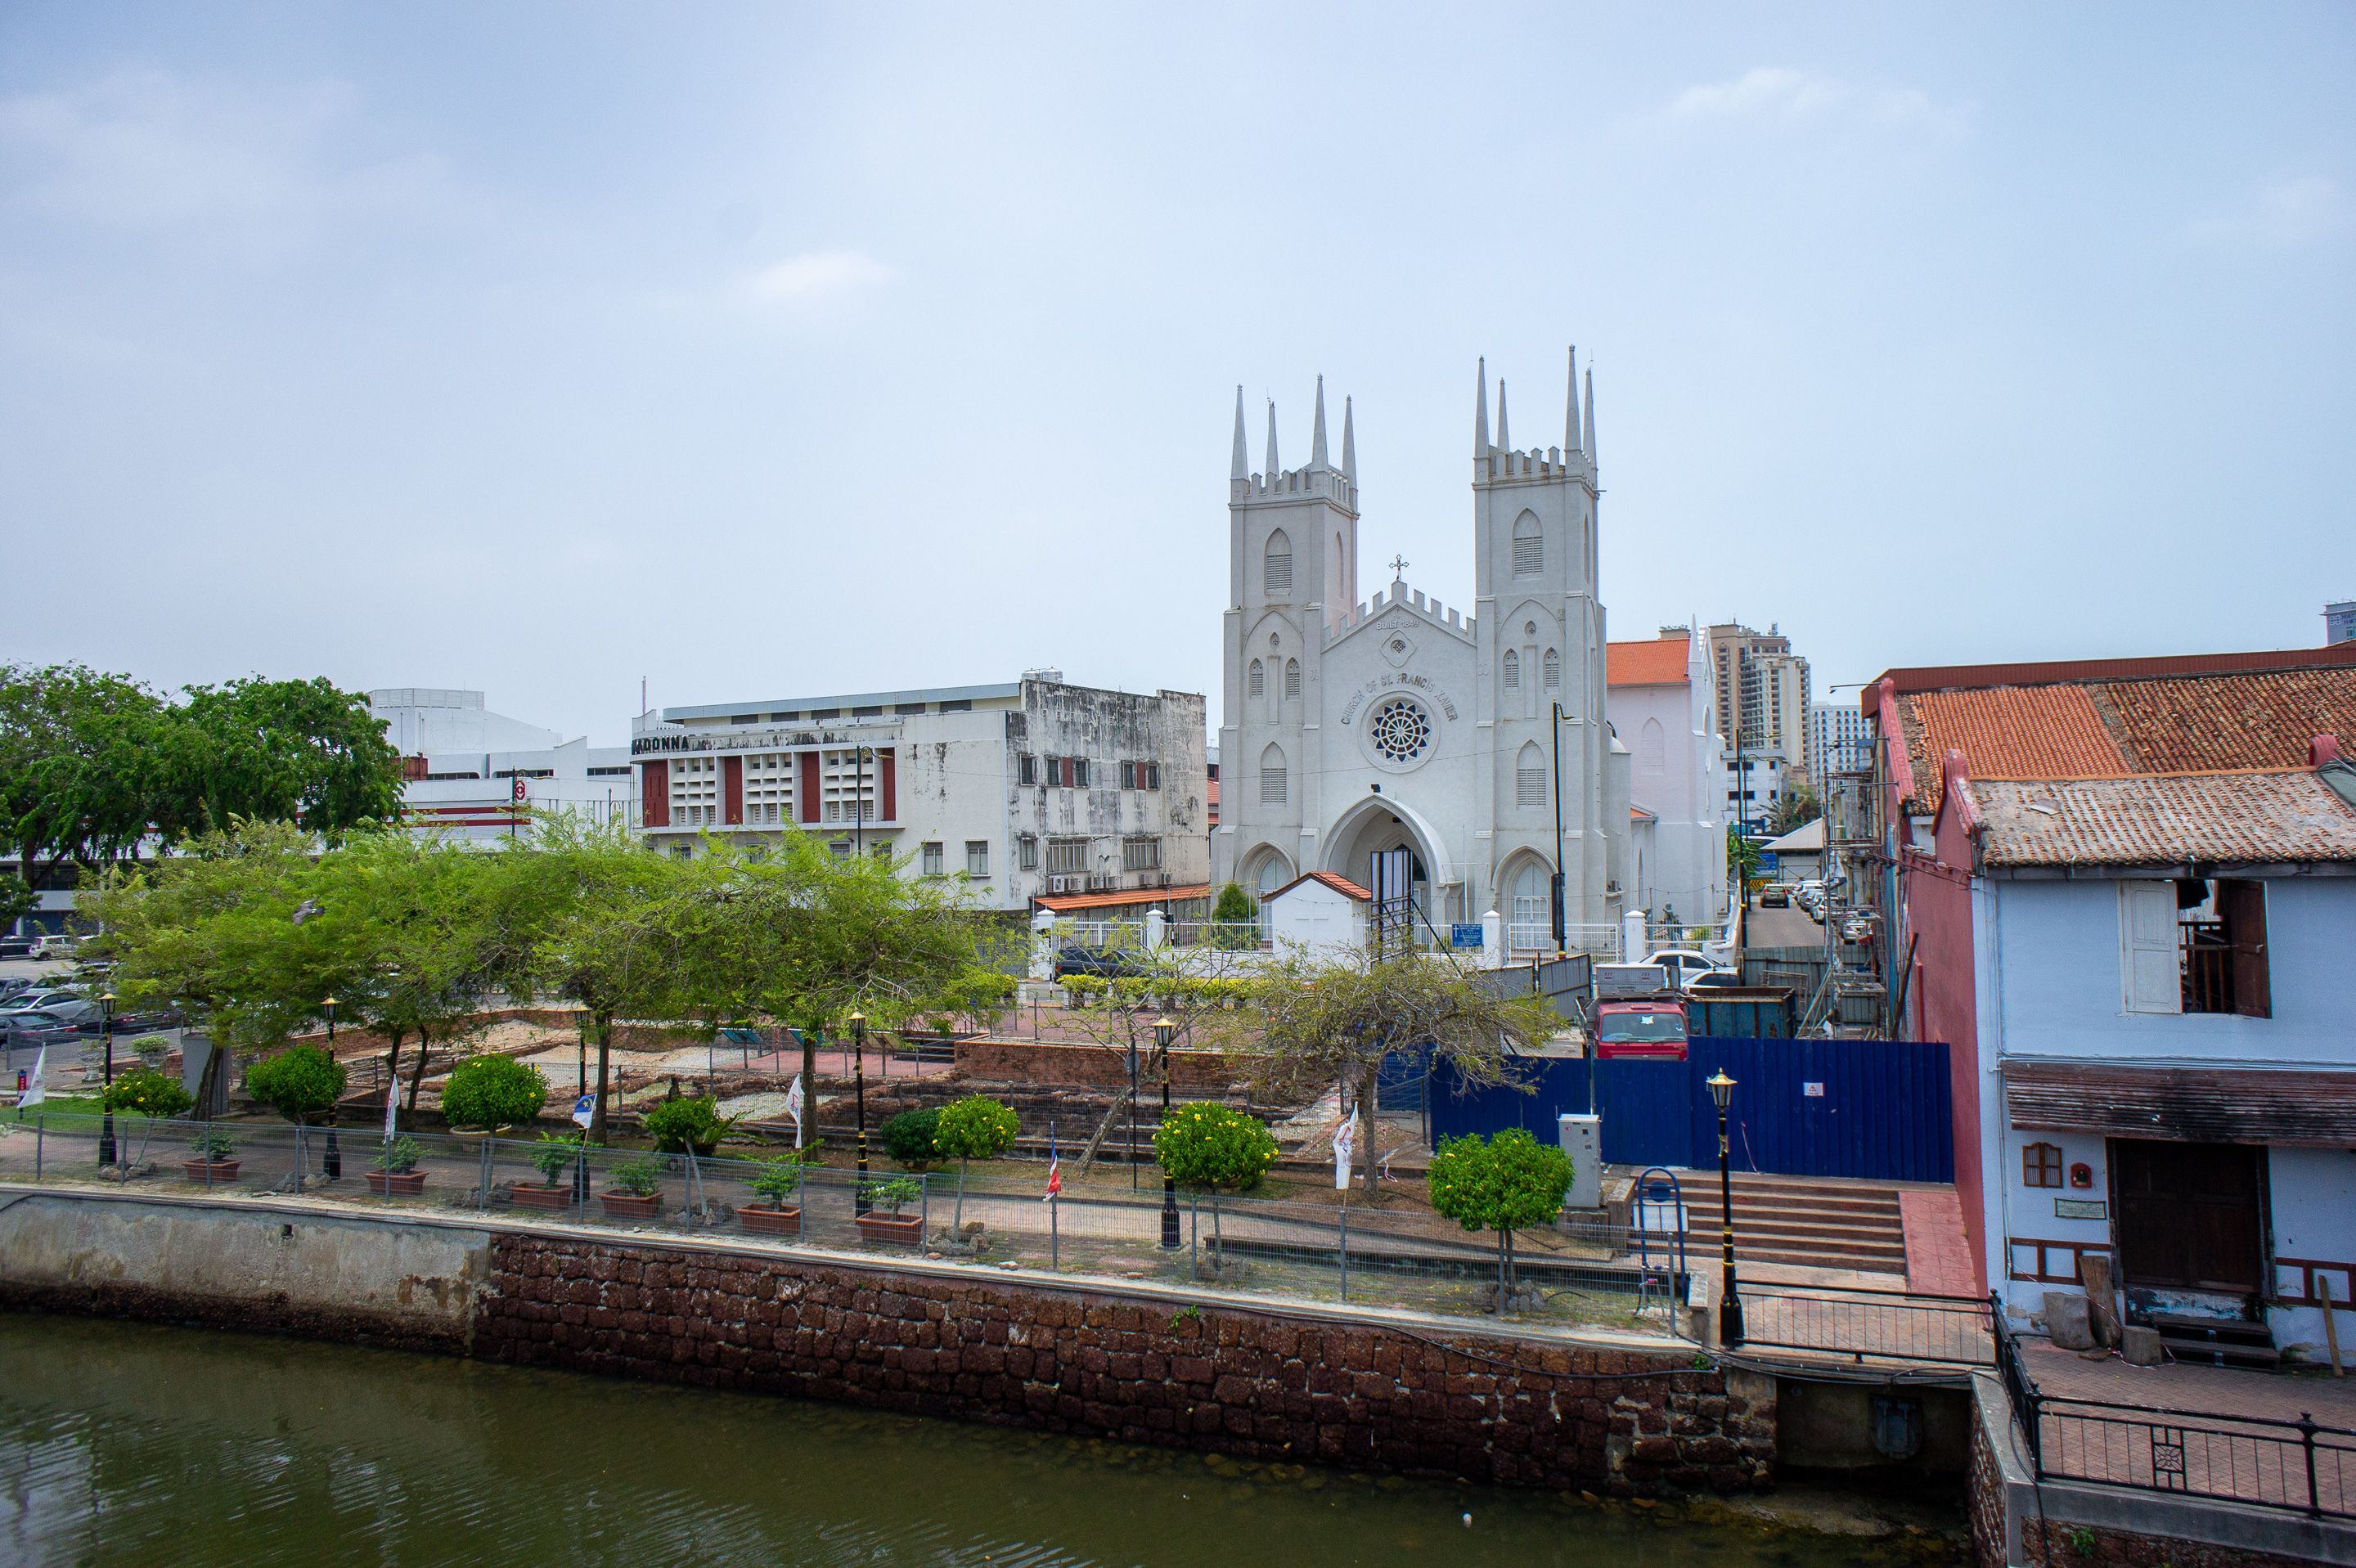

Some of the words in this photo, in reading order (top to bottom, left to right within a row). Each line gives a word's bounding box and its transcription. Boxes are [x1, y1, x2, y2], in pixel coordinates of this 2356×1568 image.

[1376, 622, 1397, 630] BUILT
[1341, 689, 1365, 725] CHURCH
[1366, 681, 1376, 693] OF
[1397, 672, 1436, 692] FRANCIS
[1434, 690, 1459, 721] XAVIER
